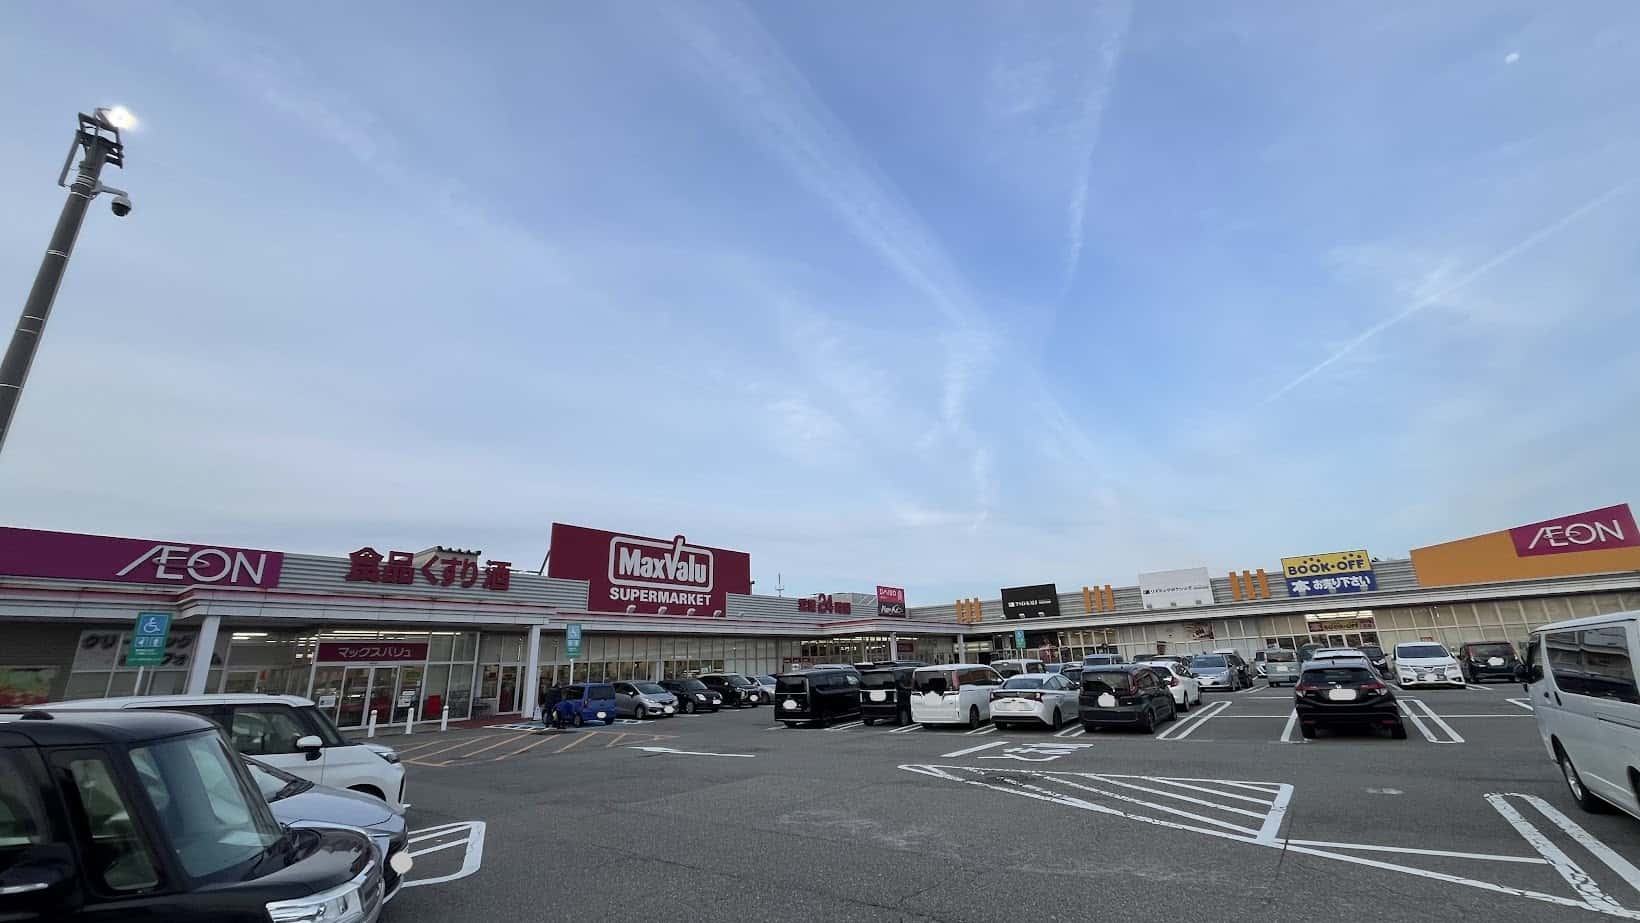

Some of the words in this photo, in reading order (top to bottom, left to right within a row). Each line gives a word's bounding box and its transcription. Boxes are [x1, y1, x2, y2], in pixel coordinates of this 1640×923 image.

[345, 547, 414, 585] 食品
[421, 555, 478, 588] くすり
[482, 560, 512, 591] 酒
[618, 537, 707, 584] MaxValu
[1291, 579, 1311, 593] 本
[1312, 575, 1370, 590] お売り下さい
[609, 587, 711, 605] SUPERMARKET
[337, 646, 412, 658] マックスバリュ
